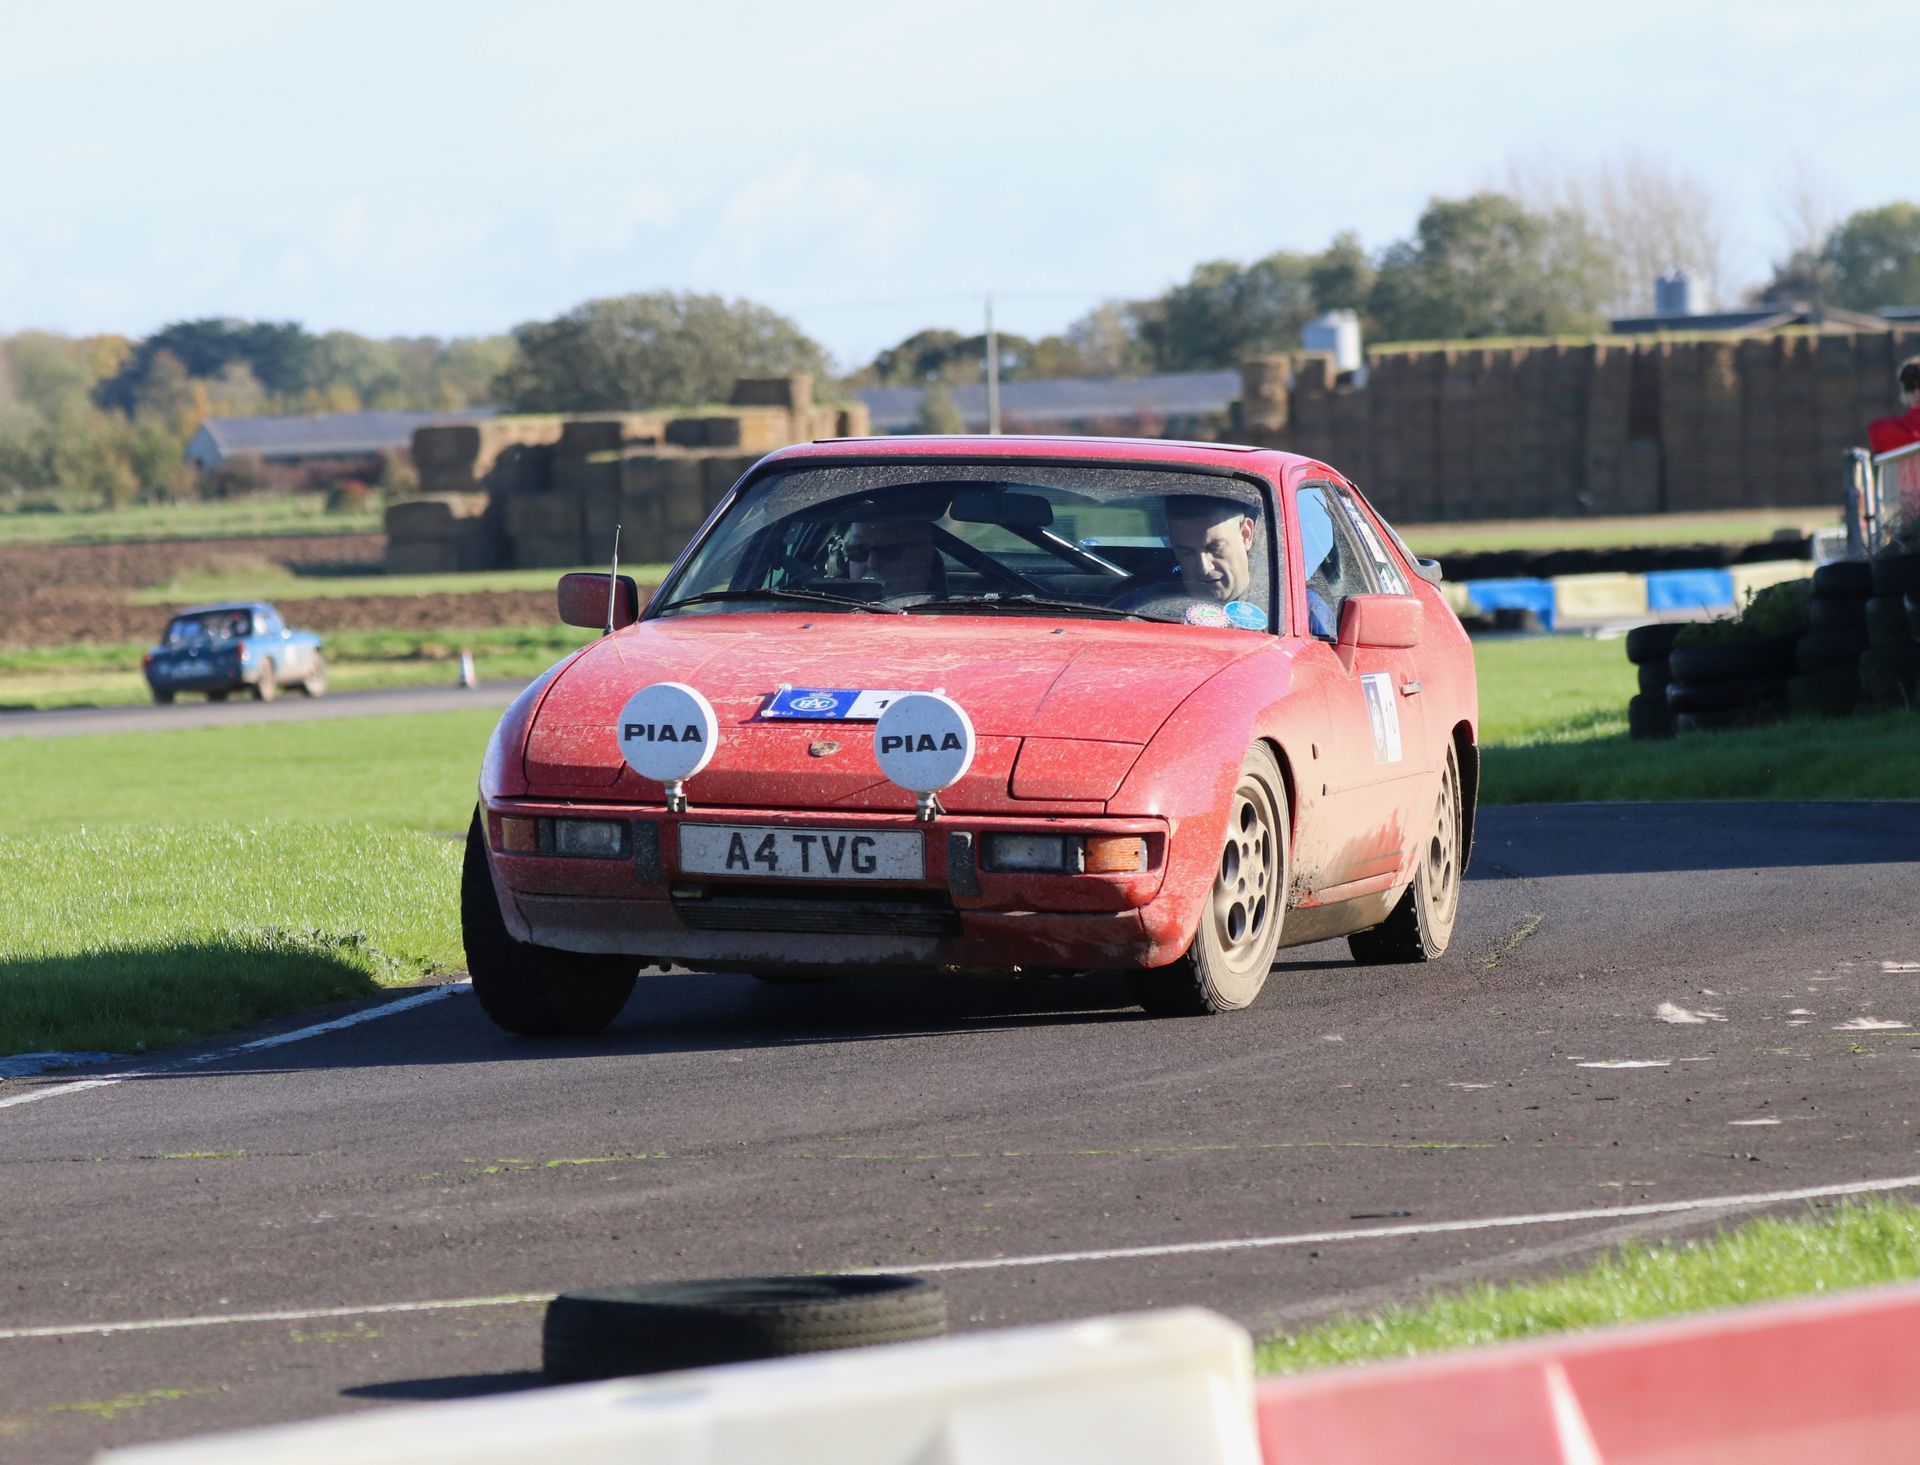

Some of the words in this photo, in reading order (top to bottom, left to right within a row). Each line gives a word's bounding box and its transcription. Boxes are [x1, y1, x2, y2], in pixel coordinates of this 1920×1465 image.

[624, 724, 703, 743] PIAA
[881, 733, 962, 754] PIAA
[725, 832, 779, 872] A4
[792, 834, 876, 874] TVG
